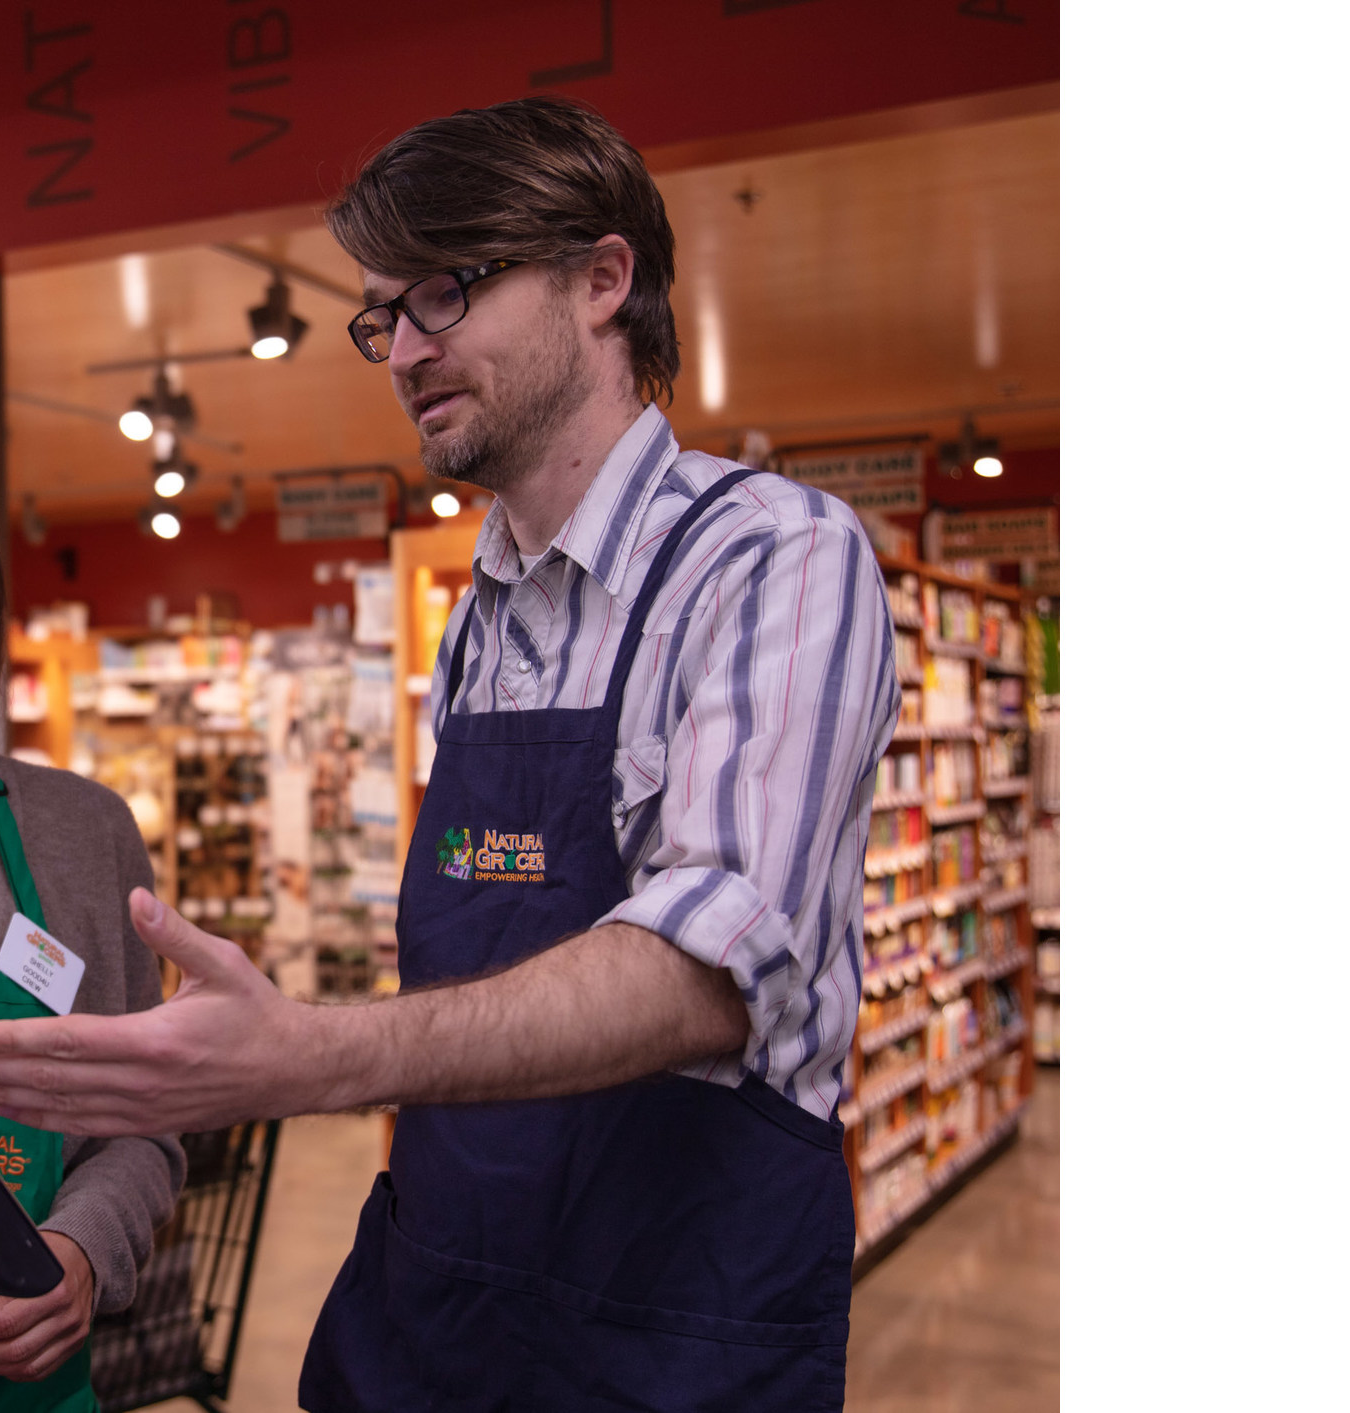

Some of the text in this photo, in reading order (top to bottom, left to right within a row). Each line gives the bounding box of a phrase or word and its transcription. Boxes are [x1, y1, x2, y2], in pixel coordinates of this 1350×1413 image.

[227, 0, 292, 164] VIB
[484, 829, 544, 850] NATURA
[475, 848, 545, 871] GROCER
[475, 871, 527, 882] EMPOWERING
[21, 975, 42, 993] CREW
